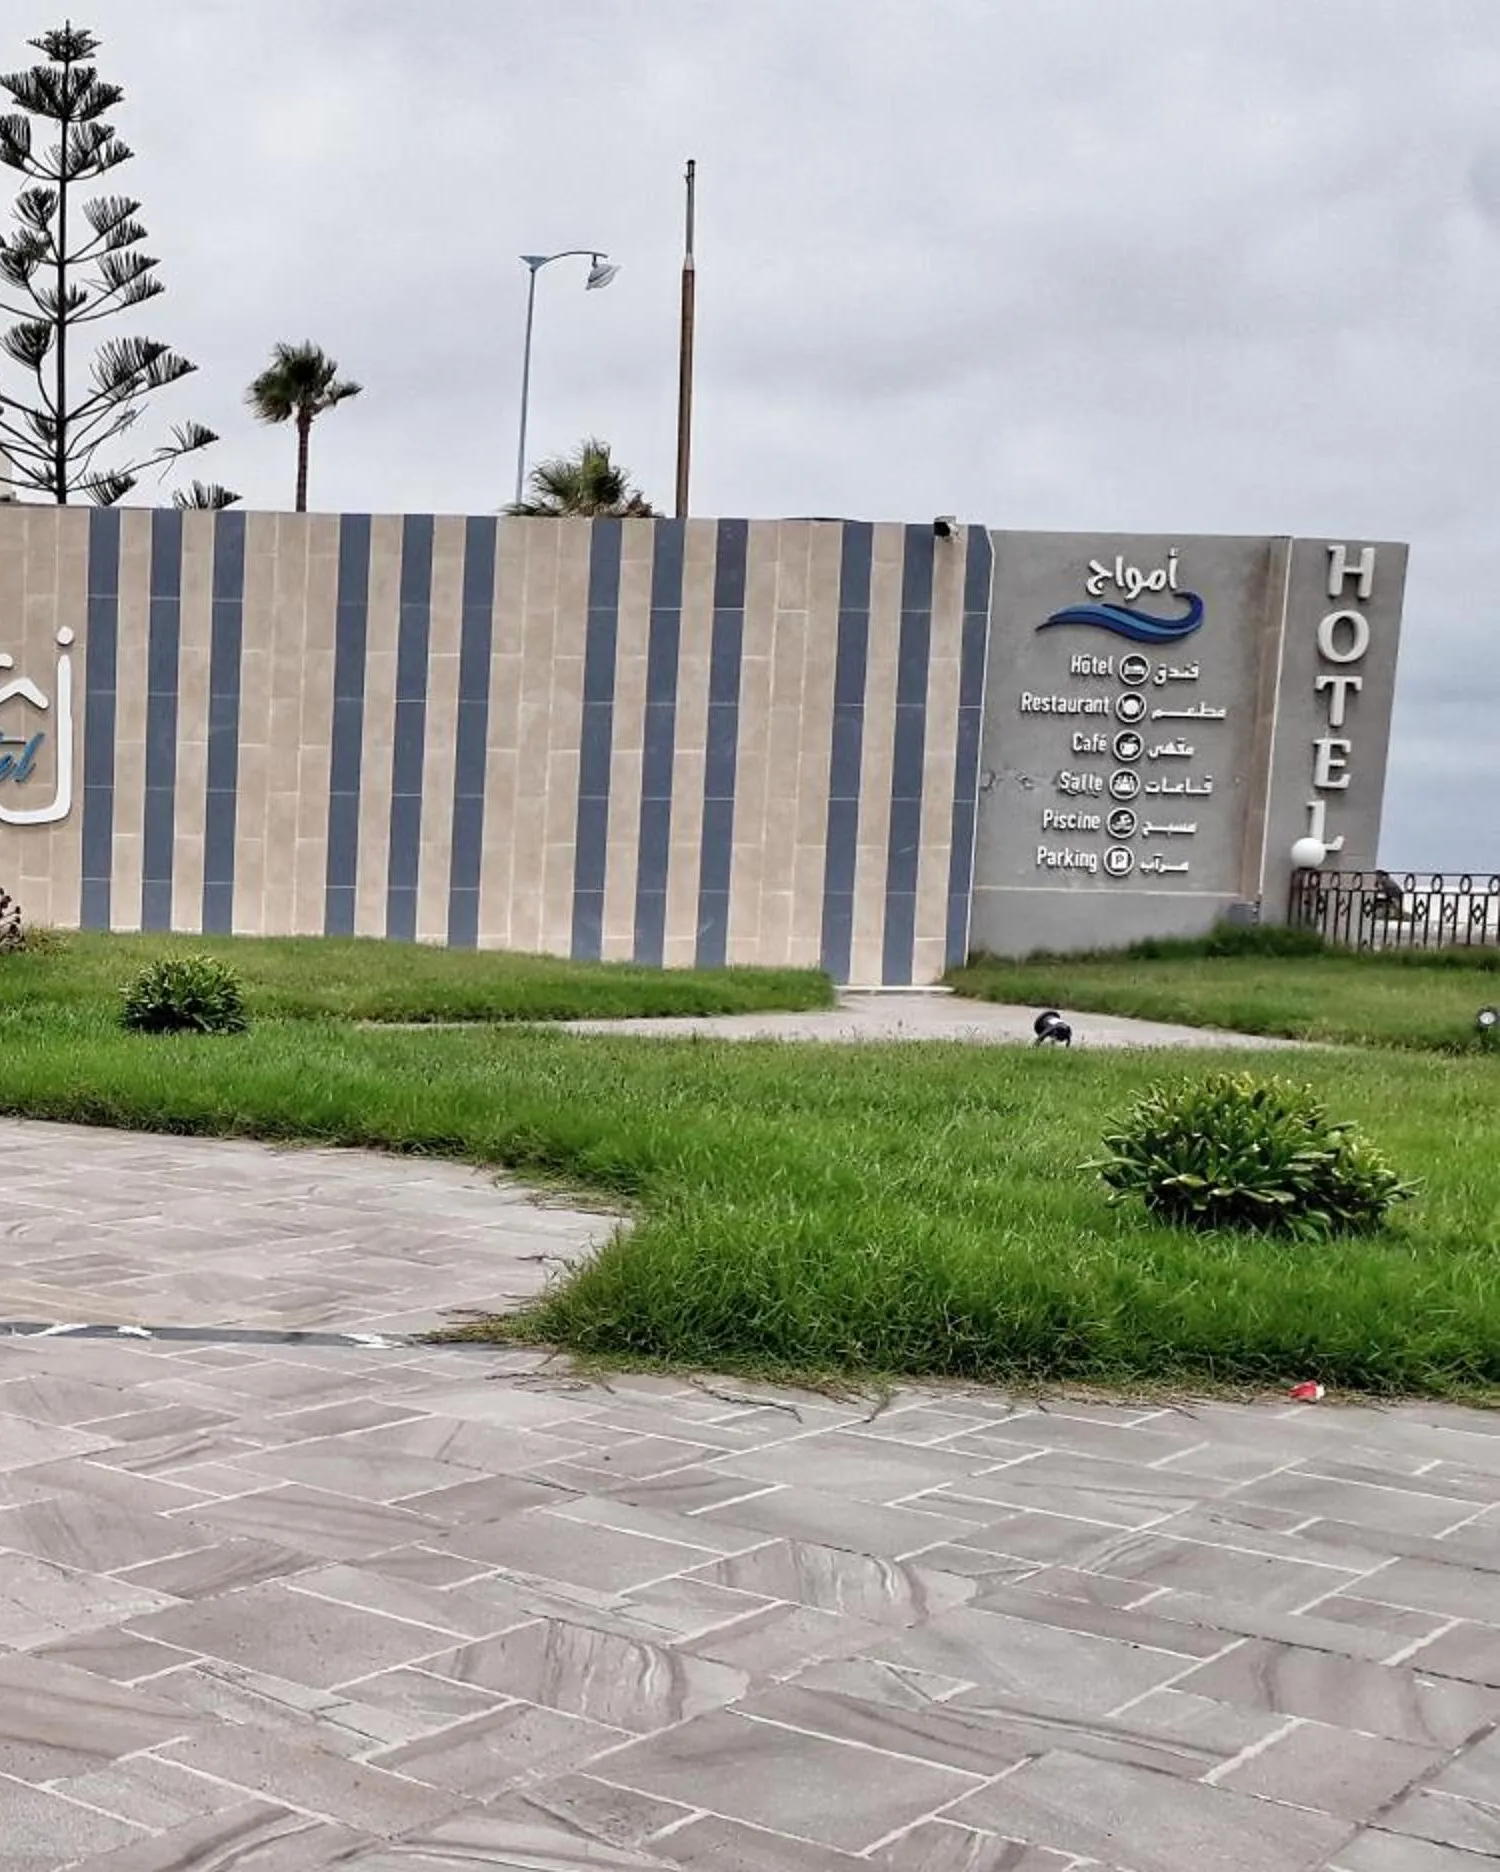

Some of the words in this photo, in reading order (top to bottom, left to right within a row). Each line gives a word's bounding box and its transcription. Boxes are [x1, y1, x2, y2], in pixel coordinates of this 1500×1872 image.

[1085, 547, 1180, 600] أمواج
[1070, 653, 1114, 676] Hôtel
[1152, 661, 1200, 685] فندق
[1020, 691, 1110, 714] Restaurant
[1305, 545, 1376, 851] HOTEL
[1072, 731, 1108, 752] Café
[1059, 771, 1104, 792] Salle
[1042, 808, 1101, 831] Piscine
[1036, 845, 1098, 873] Parking
